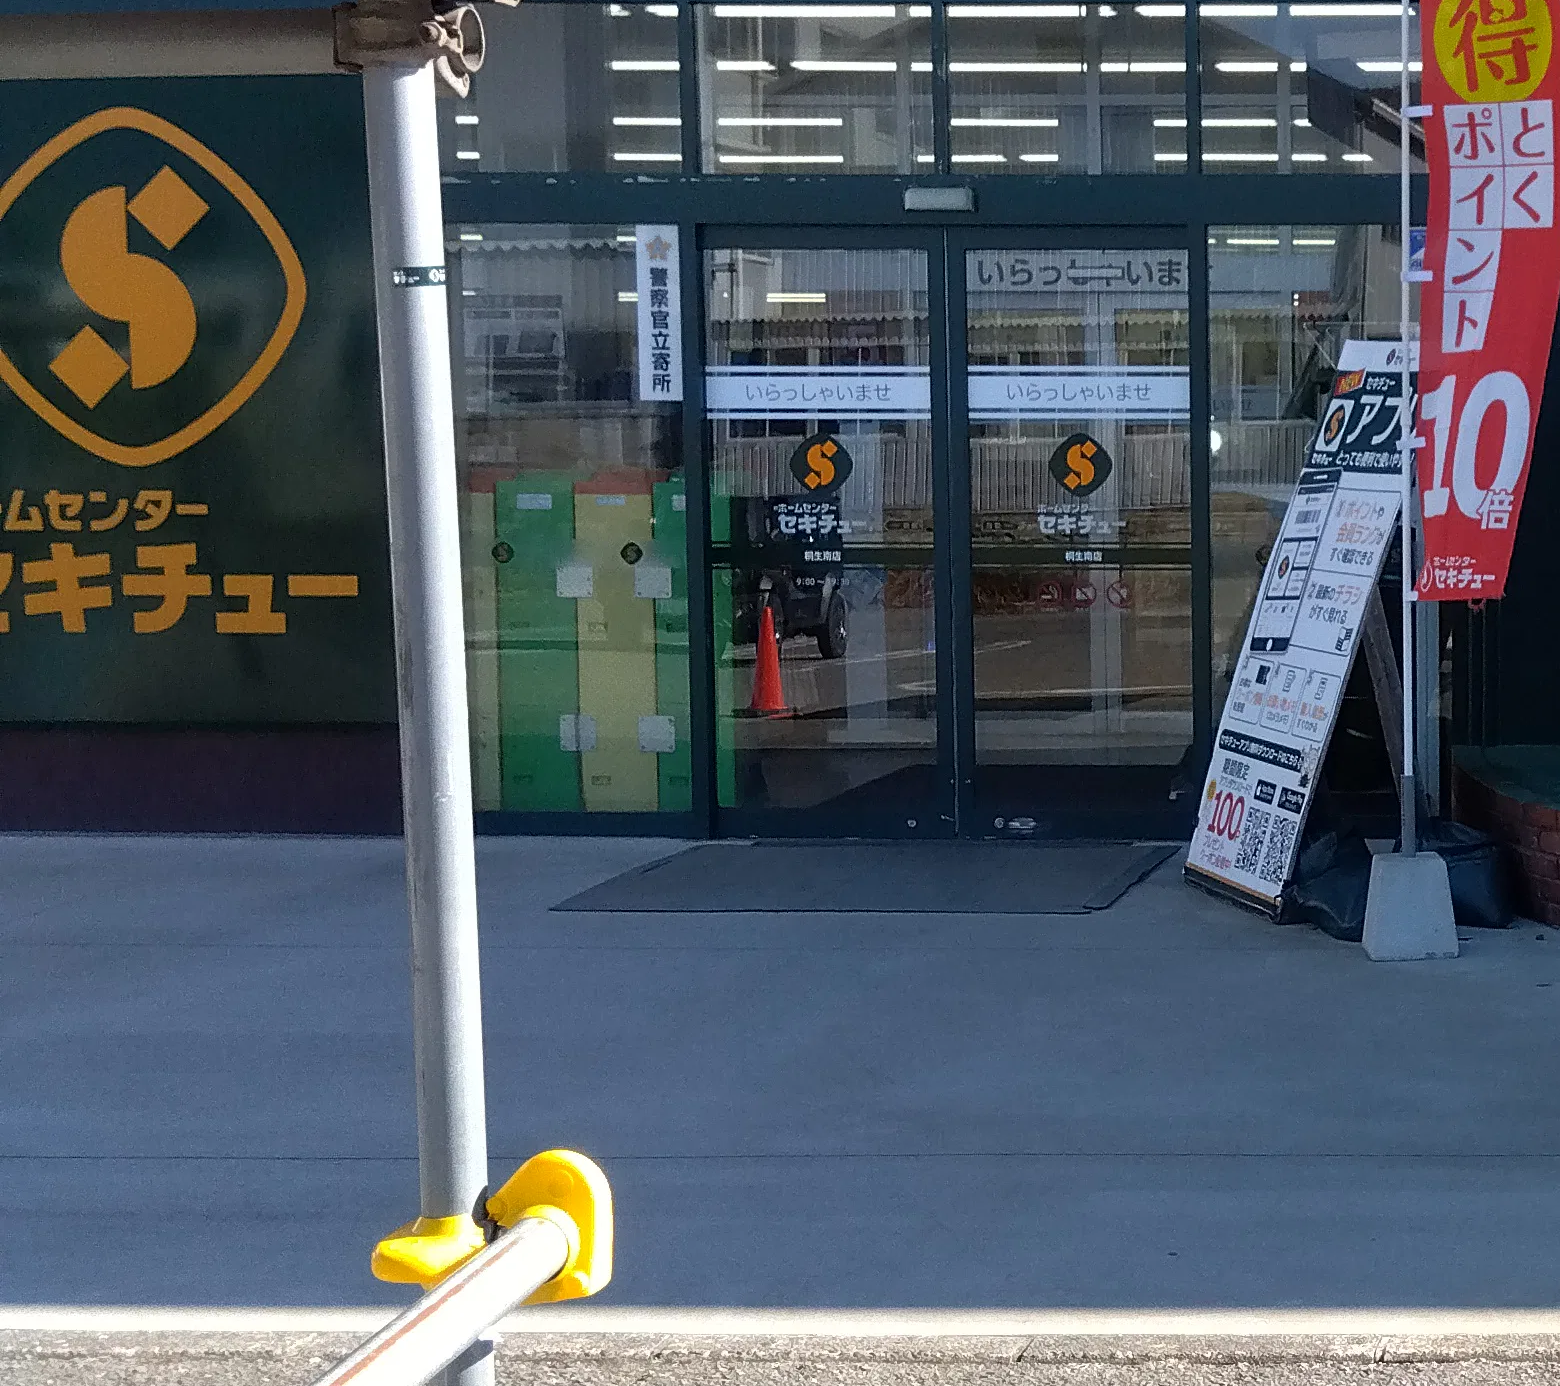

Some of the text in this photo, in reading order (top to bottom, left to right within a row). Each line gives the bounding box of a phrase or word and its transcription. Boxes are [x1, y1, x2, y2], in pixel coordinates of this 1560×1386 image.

[1511, 107, 1549, 224] とく
[1449, 107, 1498, 350] ポイント
[649, 267, 672, 394] 警察官立寄所
[745, 383, 892, 402] いらっしゃいませ
[1006, 382, 1153, 402] いらっしゃいませ
[0, 489, 209, 532] ムセンター
[777, 514, 867, 534] セキチュー
[1037, 514, 1127, 534] セキチュー
[0, 542, 359, 634] キチュー
[1434, 567, 1496, 589] セキチュー
